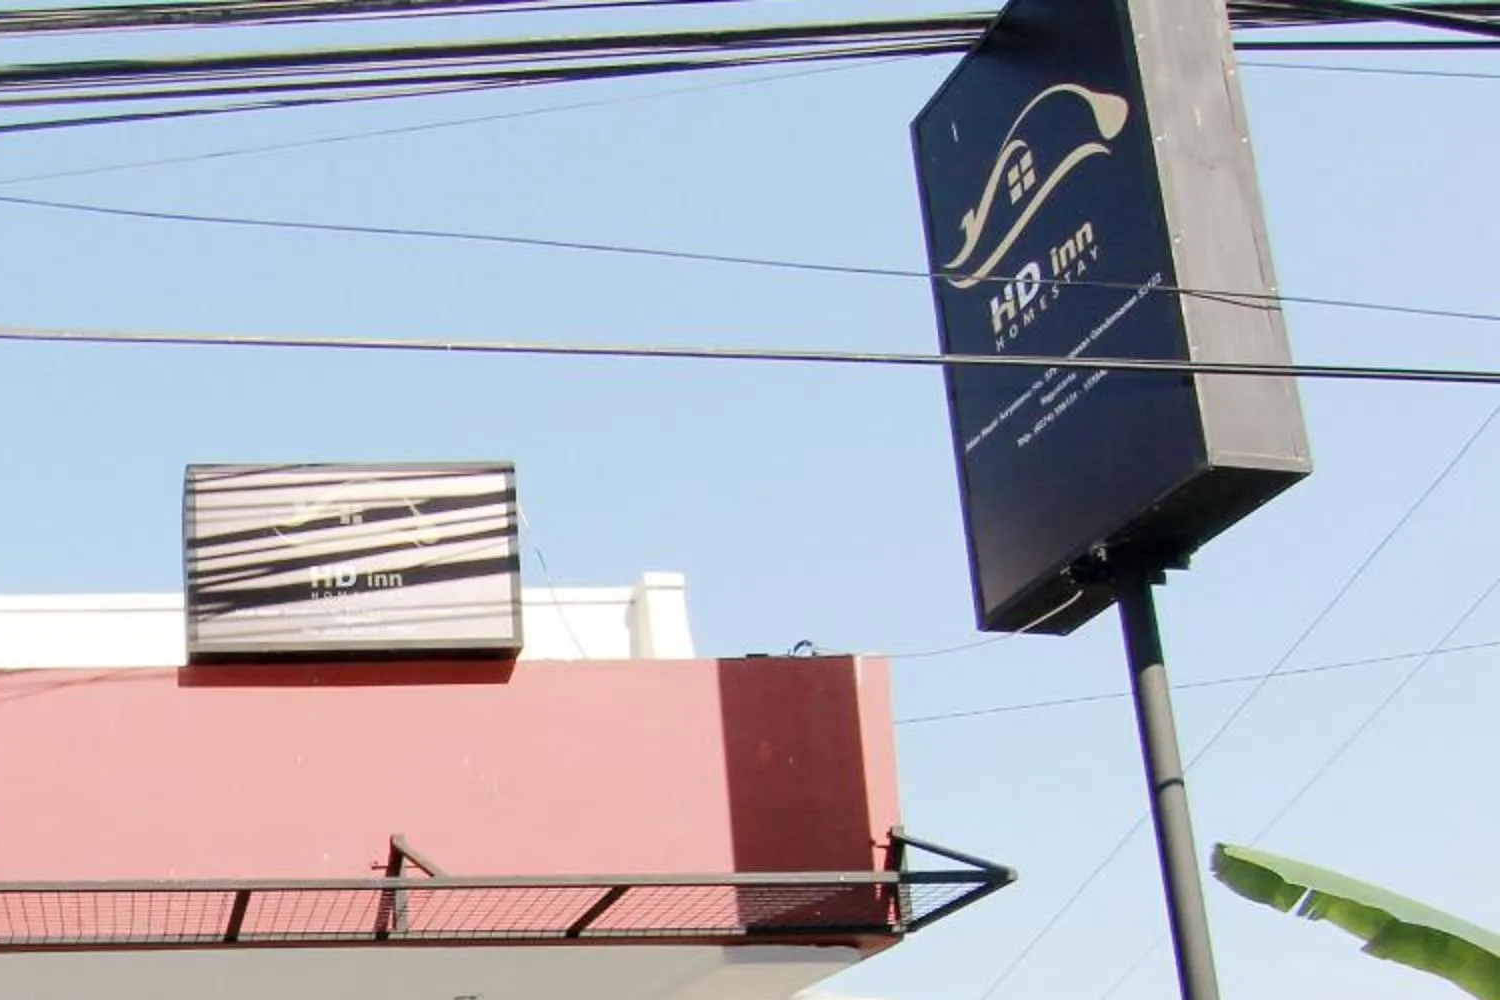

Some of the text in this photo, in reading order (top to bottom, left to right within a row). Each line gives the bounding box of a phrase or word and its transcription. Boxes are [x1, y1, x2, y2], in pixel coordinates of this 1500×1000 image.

[990, 222, 1093, 334] HD inn
[996, 245, 1098, 352] HOMESTAY
[308, 565, 403, 588] HD inn
